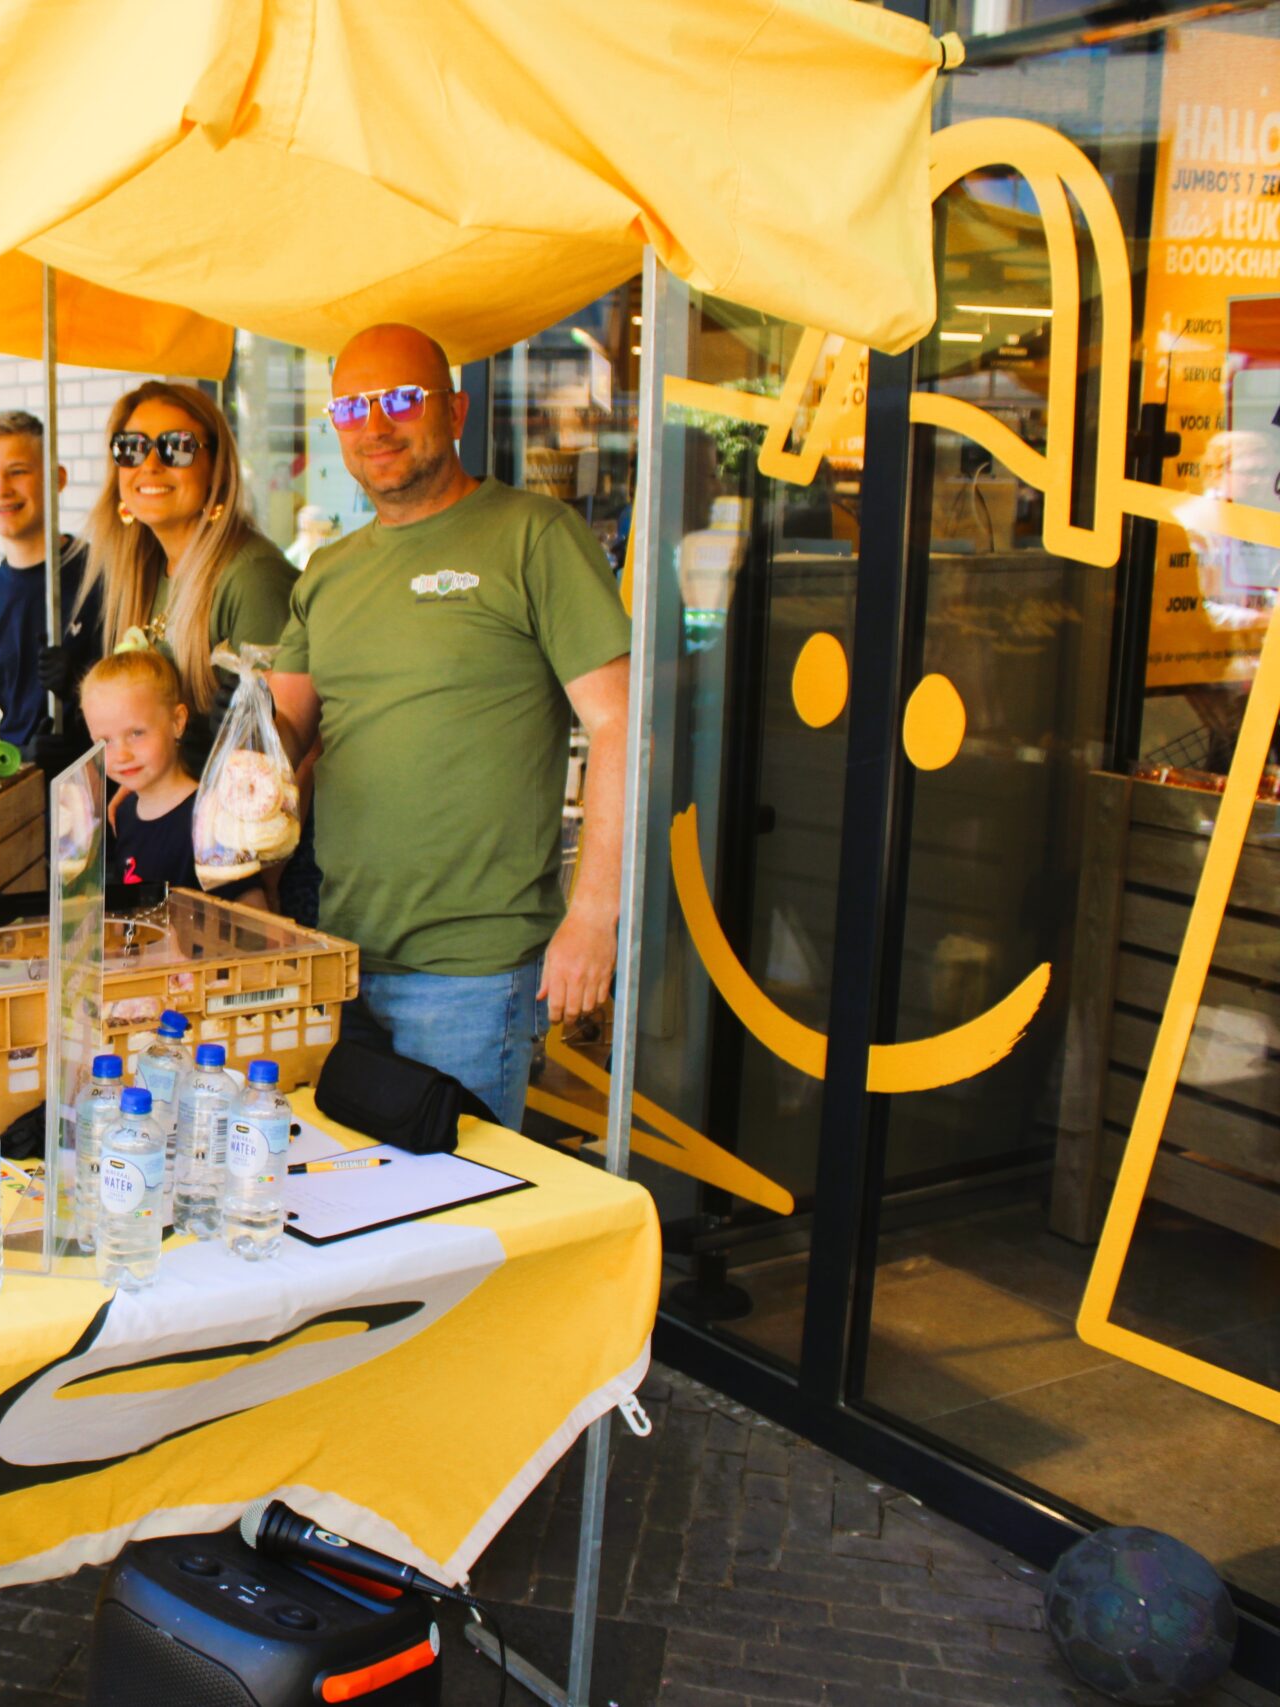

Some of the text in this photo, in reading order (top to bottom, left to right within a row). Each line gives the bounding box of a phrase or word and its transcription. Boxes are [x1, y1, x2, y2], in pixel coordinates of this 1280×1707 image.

[1172, 168, 1241, 193] JUMBO'S
[1180, 415, 1210, 431] VOOR
[1166, 597, 1198, 612] JOUW
[230, 1141, 257, 1156] WATER
[104, 1176, 133, 1192] WATER
